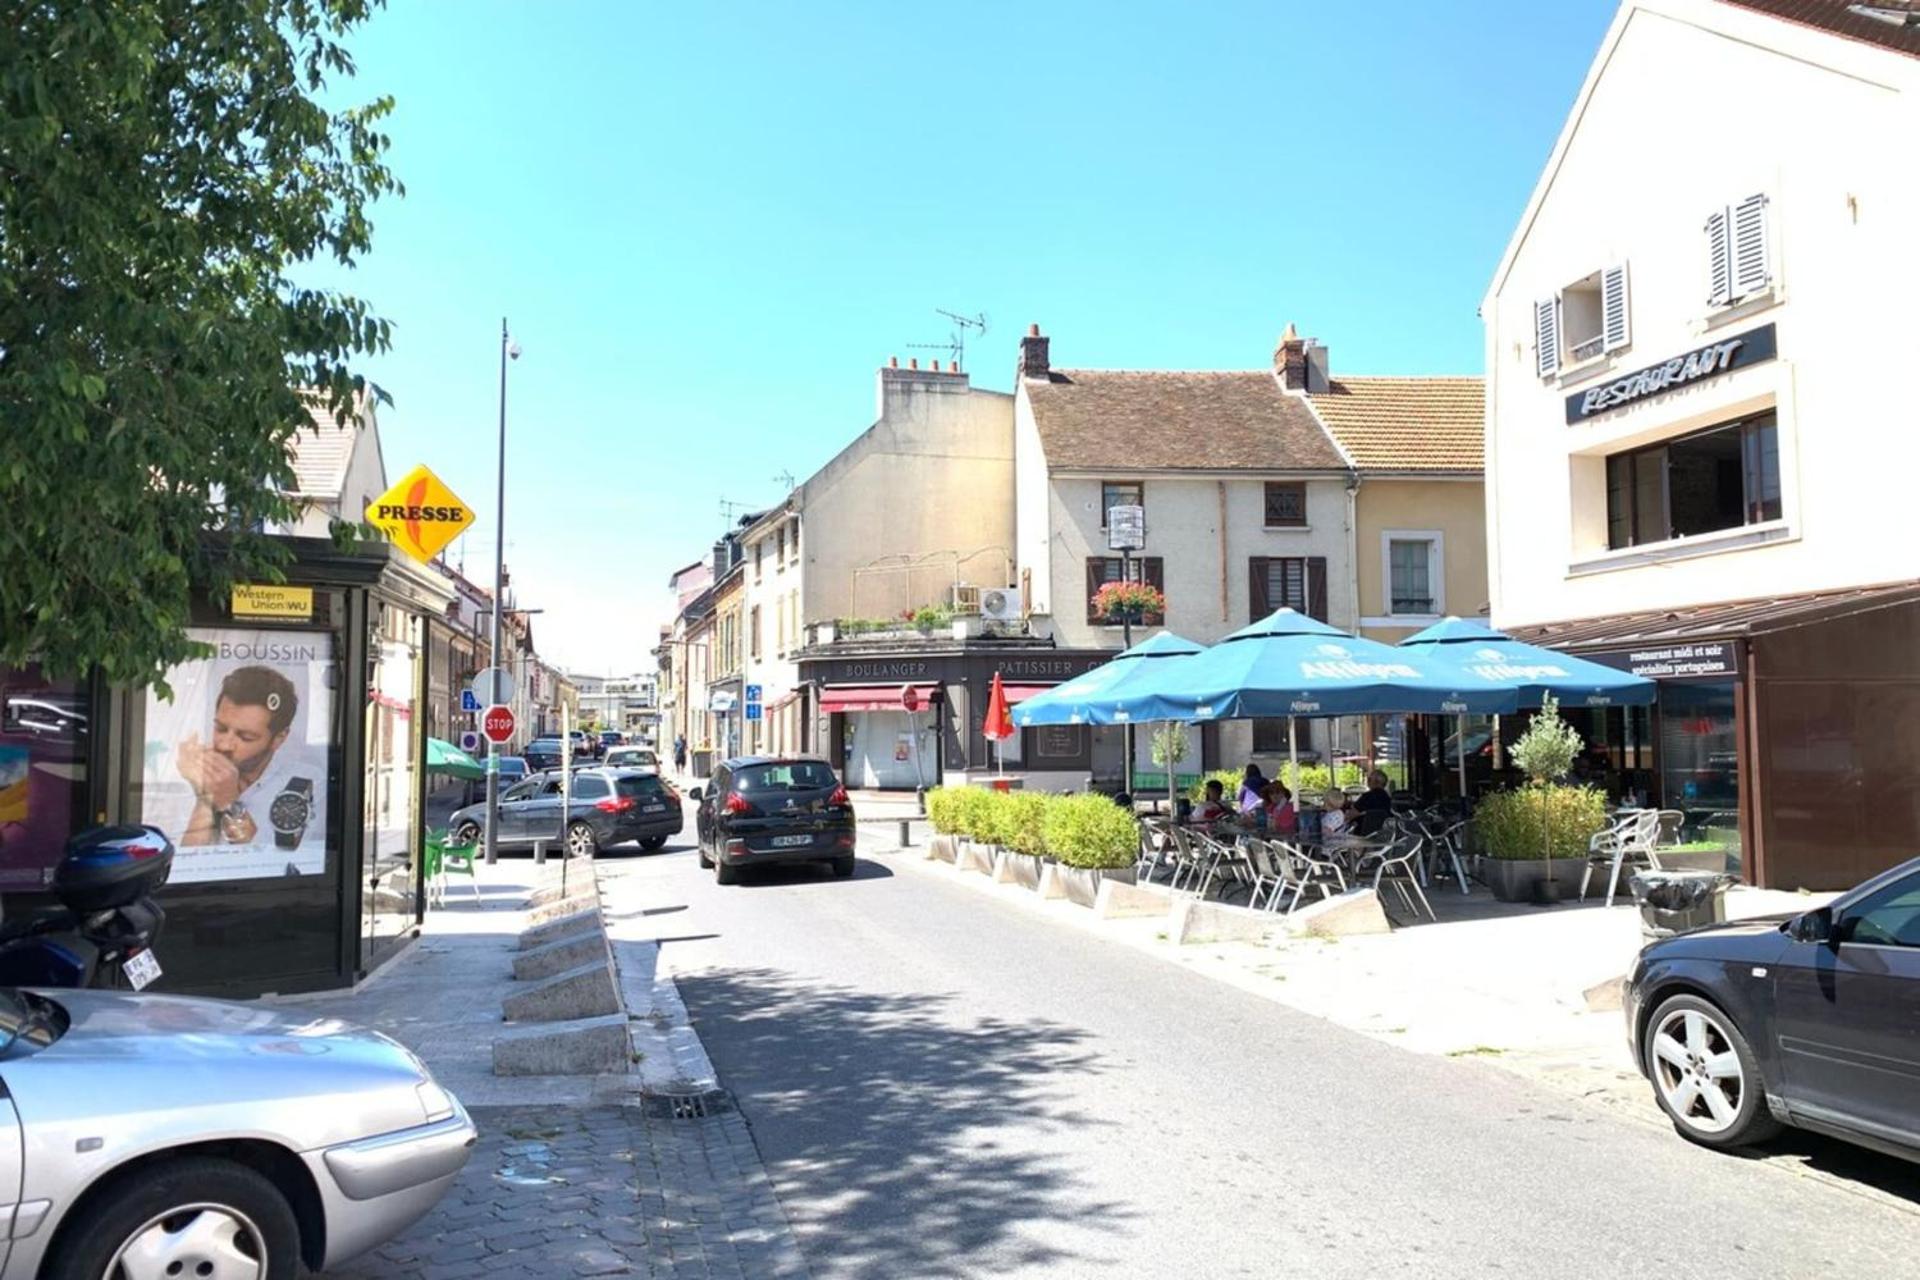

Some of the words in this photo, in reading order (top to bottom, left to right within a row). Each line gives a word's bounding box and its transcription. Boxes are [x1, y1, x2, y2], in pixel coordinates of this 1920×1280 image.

[1581, 340, 1743, 413] RESTAURANT
[378, 505, 463, 522] PRESSE
[236, 588, 284, 600] Western
[251, 600, 284, 610] Union
[287, 601, 307, 611] WU
[219, 642, 316, 661] BOUSSIN
[1630, 650, 1673, 662] restaurant
[1674, 648, 1693, 658] midi
[1695, 647, 1704, 656] et
[1705, 644, 1723, 656] soir
[846, 663, 928, 677] BOULANGER
[998, 661, 1073, 674] PATISSIER
[1674, 661, 1725, 677] portugaises
[487, 718, 513, 731] STOP
